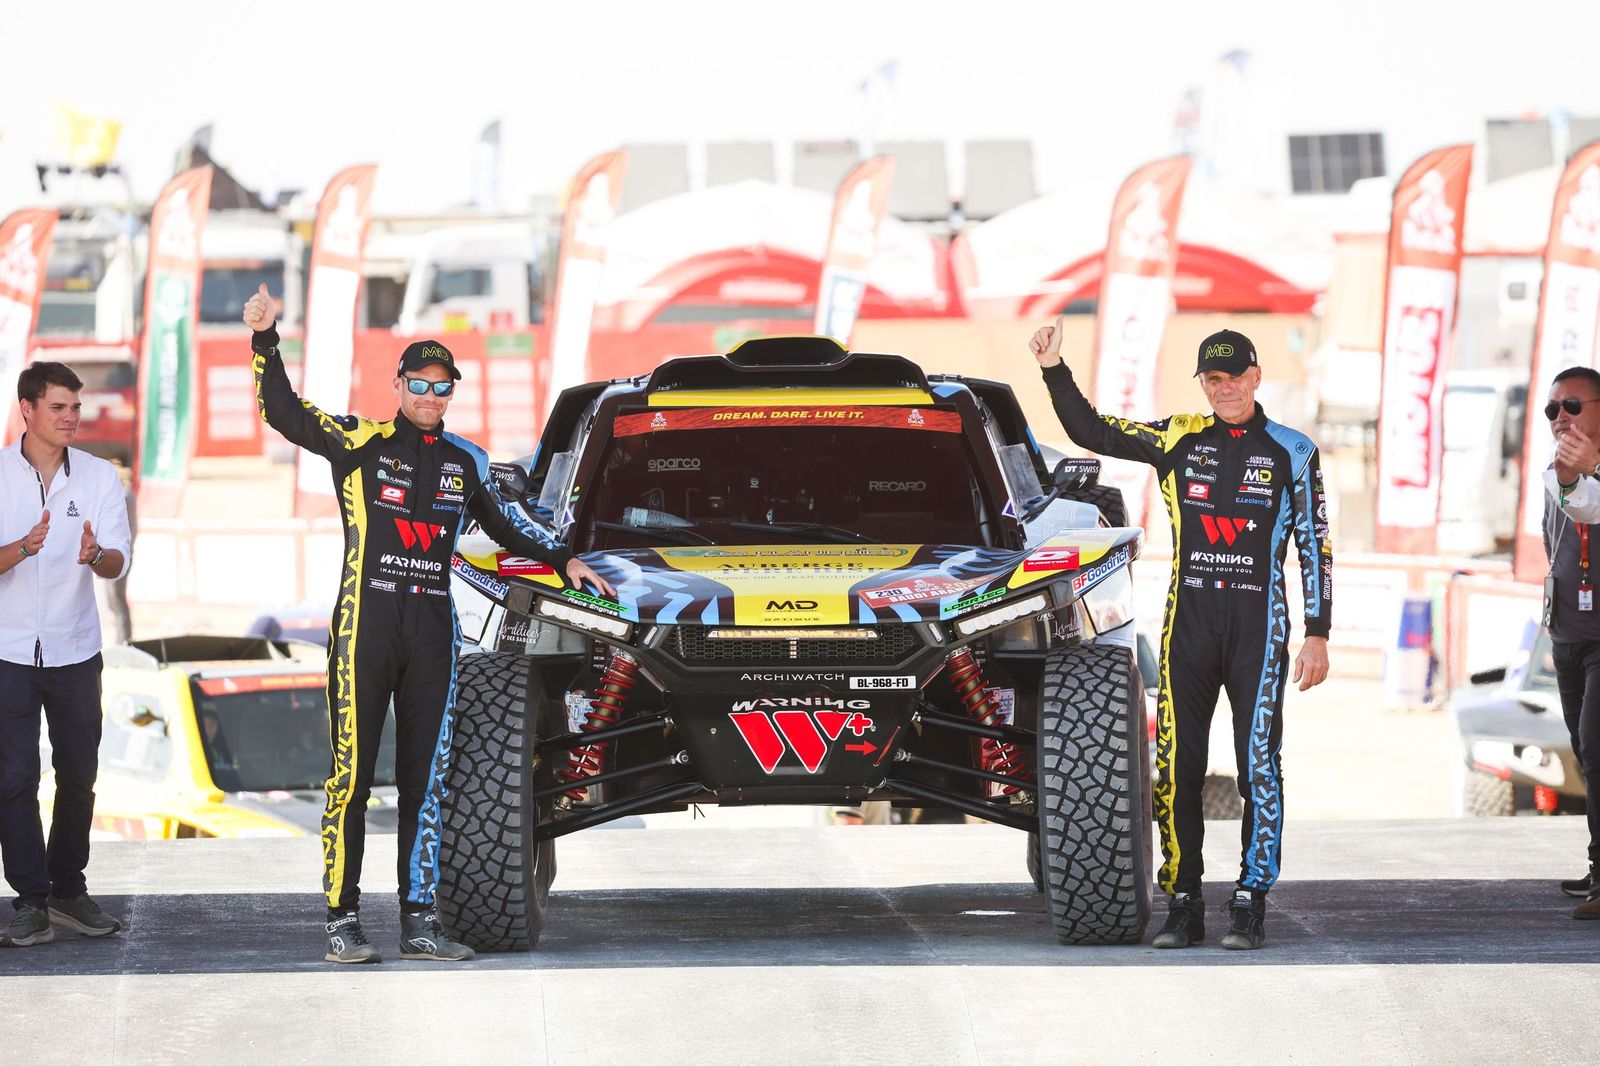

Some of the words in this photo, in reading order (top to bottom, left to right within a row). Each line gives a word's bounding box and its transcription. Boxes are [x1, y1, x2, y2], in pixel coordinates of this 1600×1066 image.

[713, 411, 767, 420] DREAM.
[770, 411, 812, 419] DARE.
[815, 411, 846, 419] LIVE
[849, 411, 865, 419] IT.
[648, 458, 701, 472] sparco
[1064, 465, 1078, 473] DT
[1079, 465, 1099, 474] SWISS
[494, 471, 516, 482] SWISS
[1243, 468, 1272, 483] MD
[439, 475, 464, 490] MD
[869, 480, 927, 491] RECARO
[1072, 545, 1131, 592] BFGoodrich
[410, 571, 426, 579] POUR
[450, 555, 508, 597] BFGoodrich
[875, 589, 903, 598] 230
[888, 594, 927, 603] SAUDI
[567, 597, 588, 607] Race
[589, 603, 619, 616] Engines
[765, 600, 819, 610] MD
[740, 673, 845, 681] ARCHIWATCH
[856, 678, 909, 688] BL-968-FD
